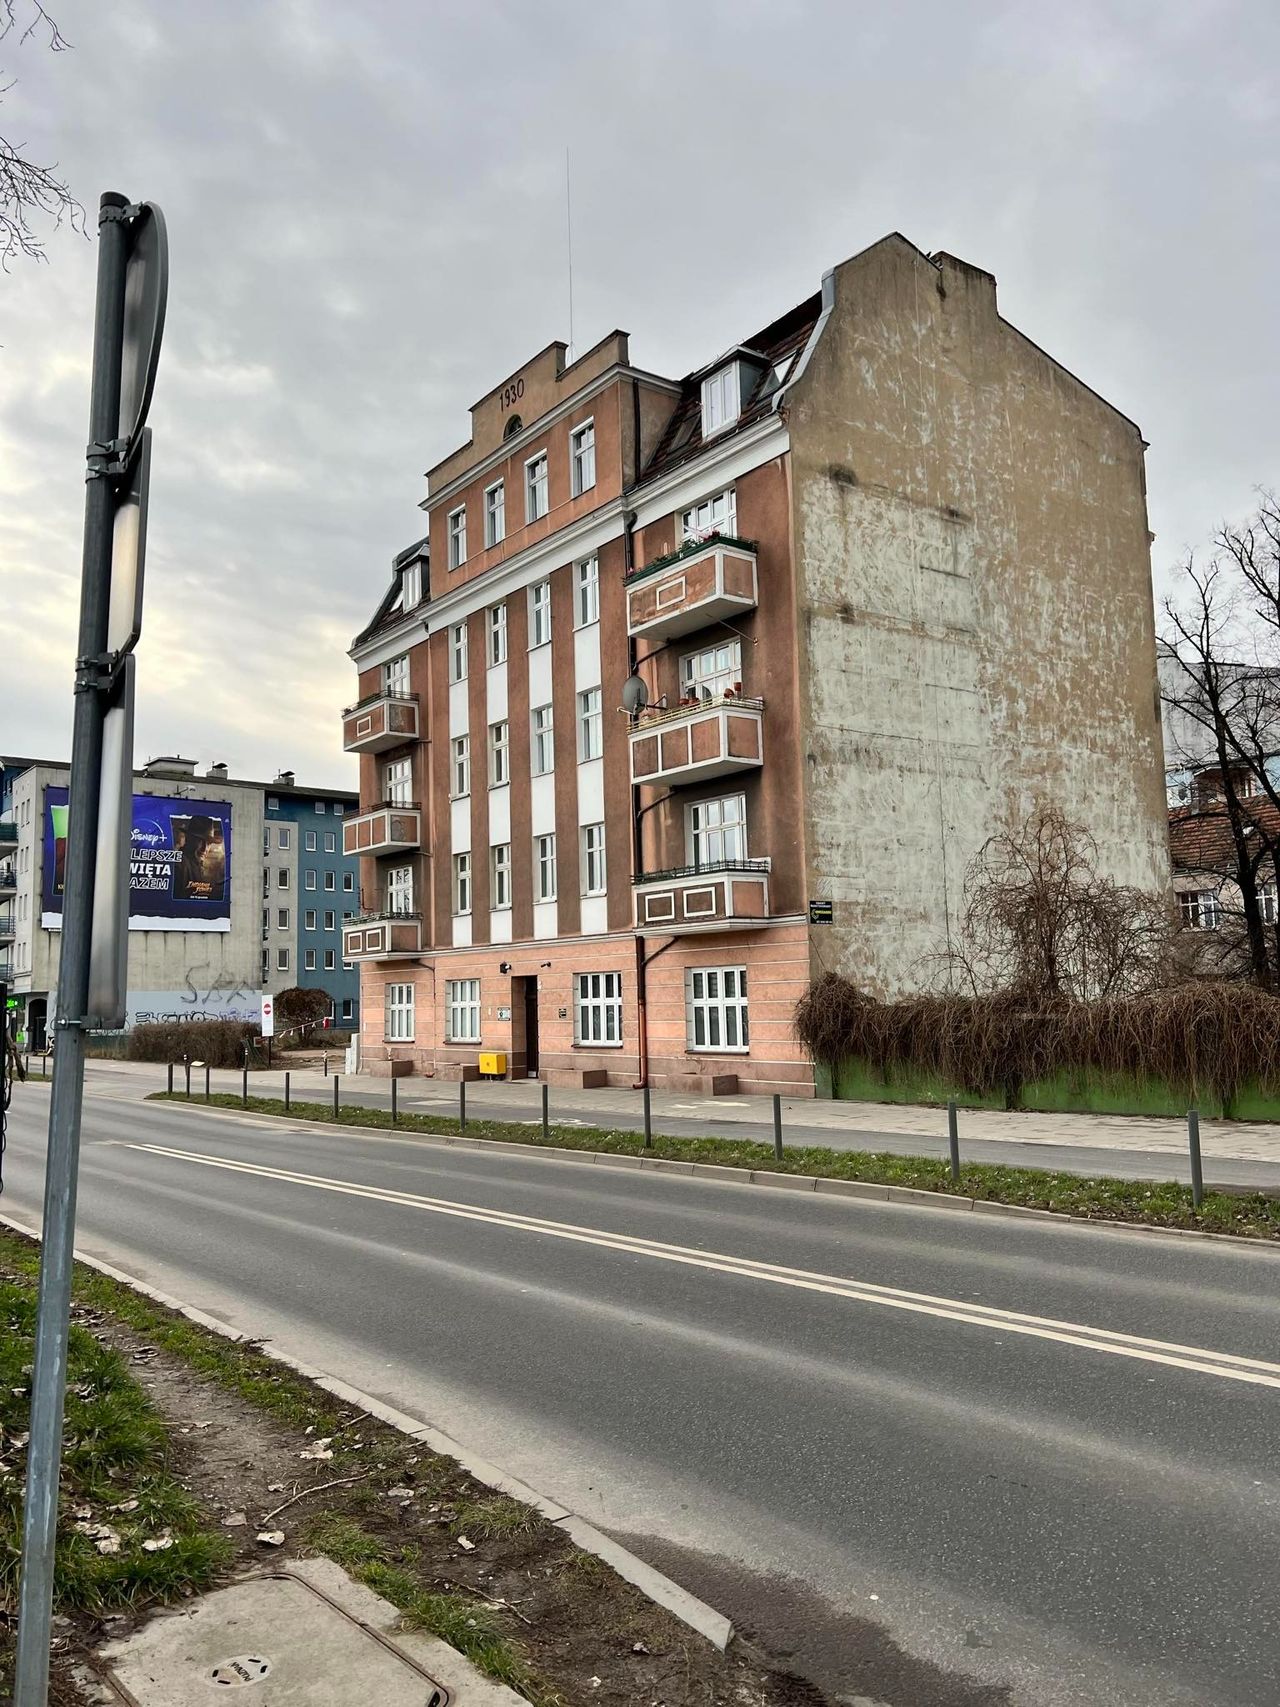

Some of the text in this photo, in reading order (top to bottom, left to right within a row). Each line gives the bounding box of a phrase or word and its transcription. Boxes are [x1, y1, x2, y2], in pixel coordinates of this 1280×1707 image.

[500, 378, 525, 413] 1930
[130, 848, 183, 862] LEPSZE
[129, 862, 171, 878] WIĘTA
[129, 877, 170, 890] AZEM
